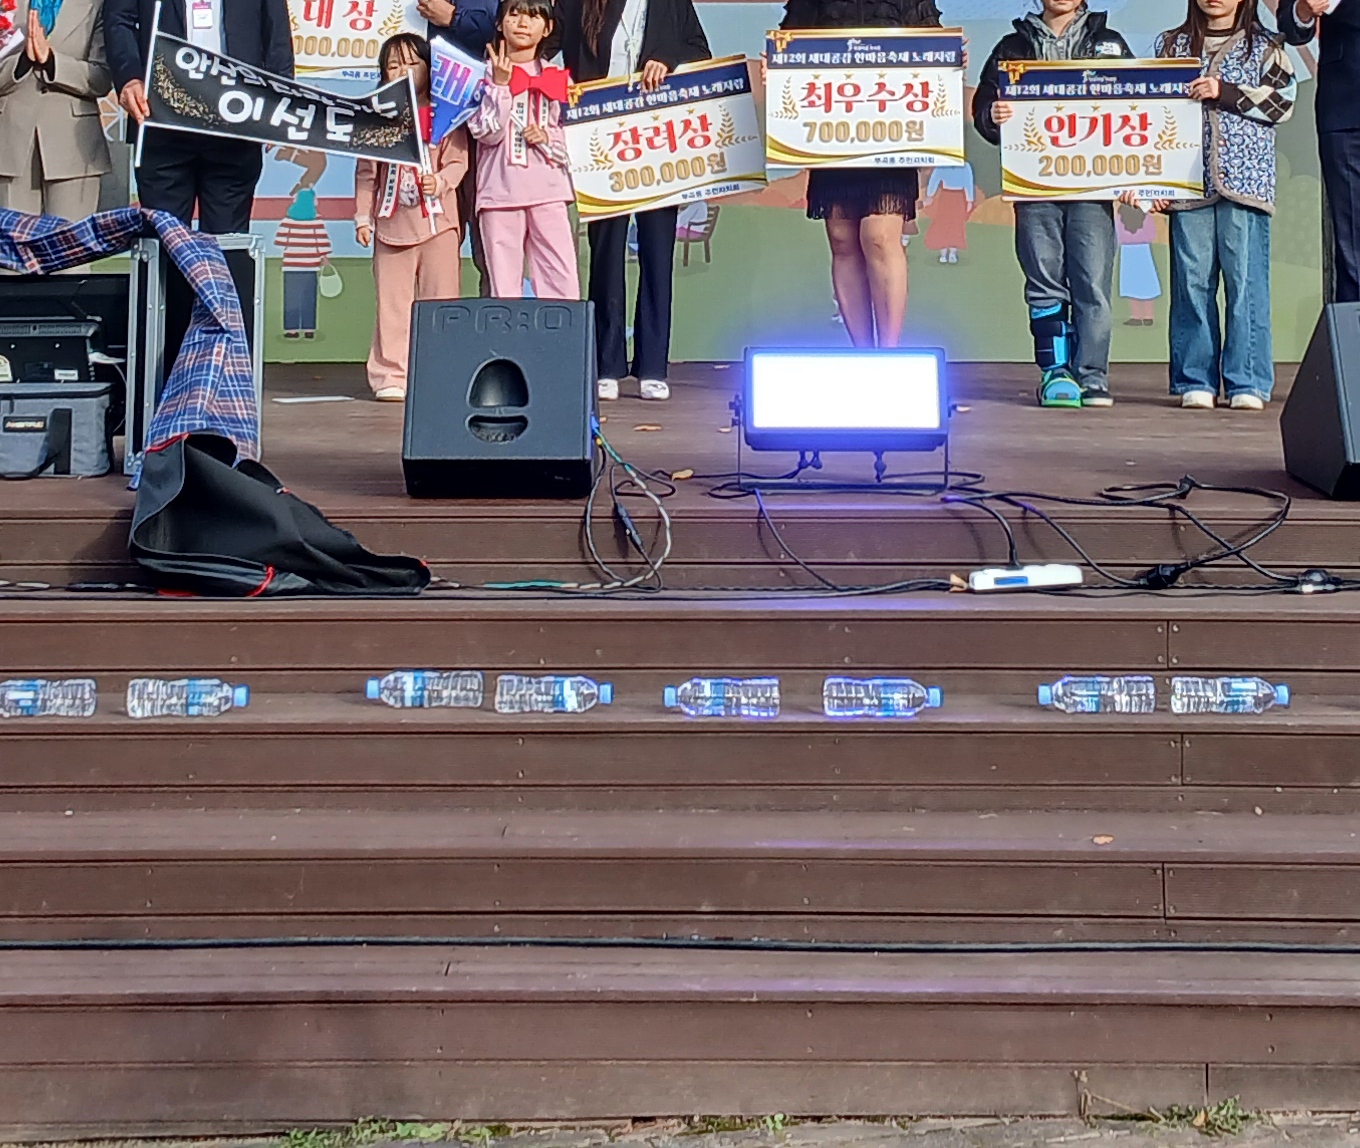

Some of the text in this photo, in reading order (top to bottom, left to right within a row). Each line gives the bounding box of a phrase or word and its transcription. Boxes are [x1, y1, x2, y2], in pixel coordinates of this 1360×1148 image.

[800, 81, 934, 113] 최우수상
[606, 113, 712, 162] 장려상
[802, 119, 925, 144] 700,000원
[1044, 112, 1153, 148] 인기상
[608, 151, 728, 192] 300,000원
[1039, 154, 1163, 177] 200,000원
